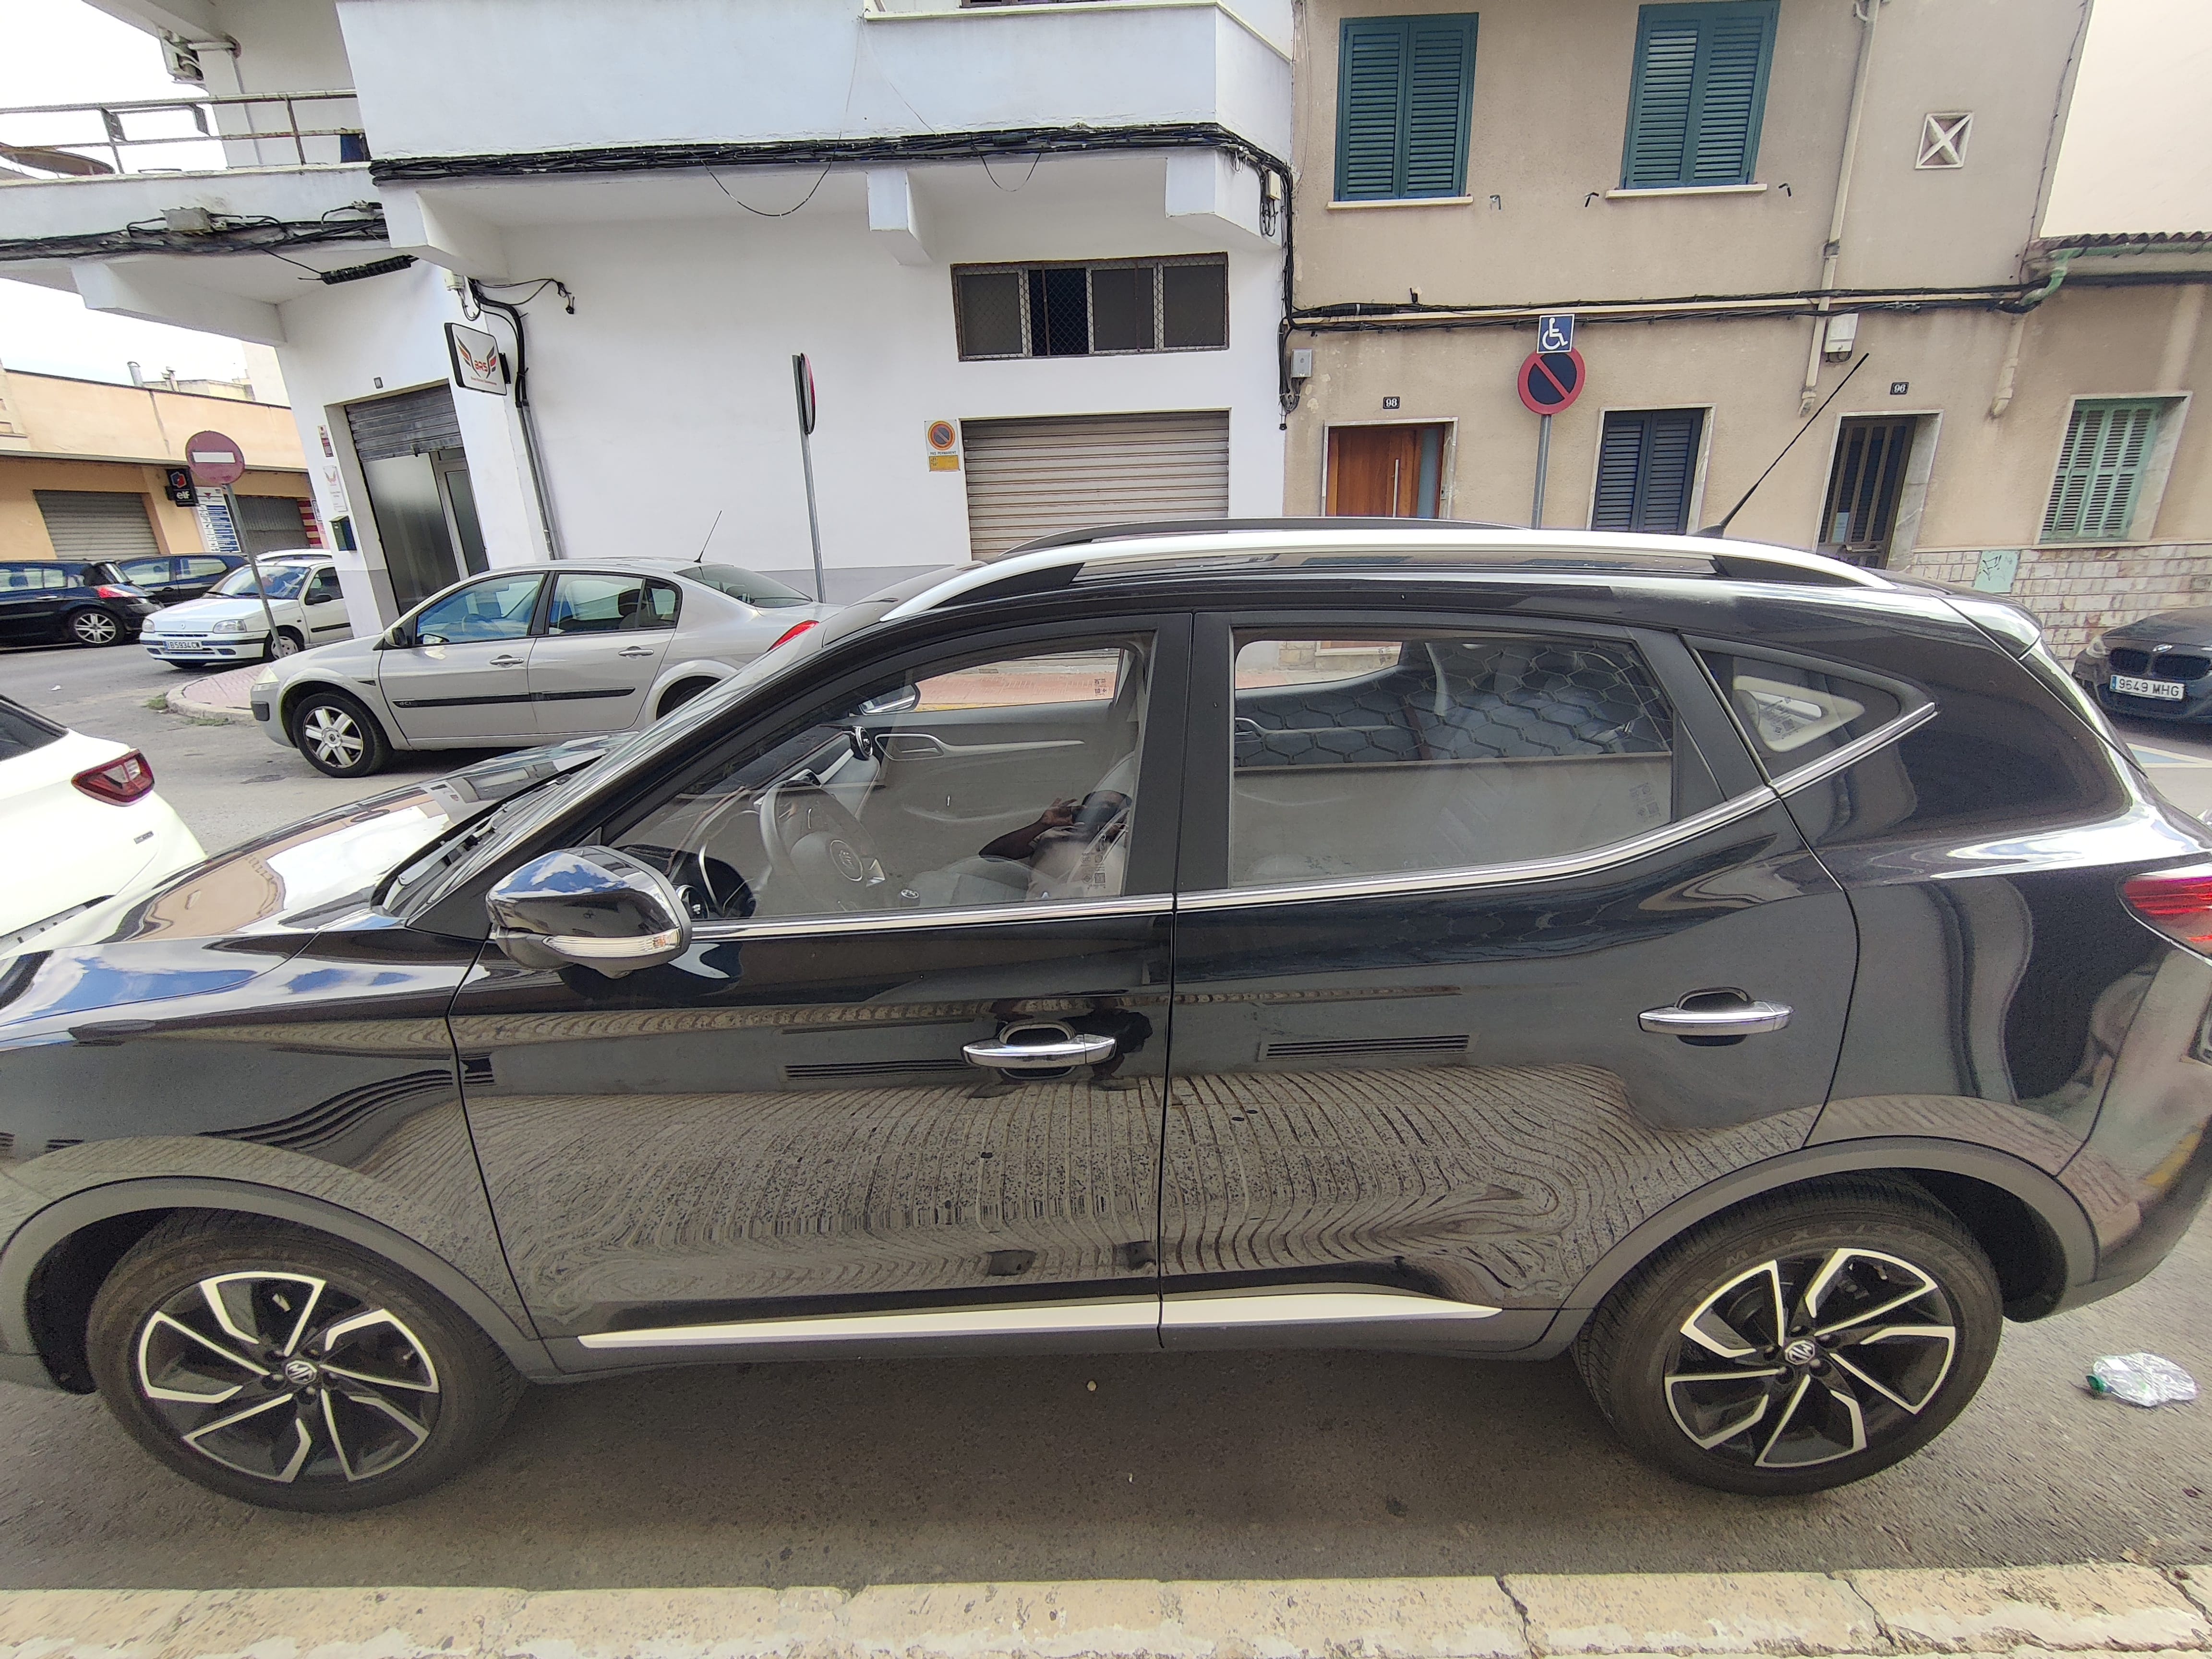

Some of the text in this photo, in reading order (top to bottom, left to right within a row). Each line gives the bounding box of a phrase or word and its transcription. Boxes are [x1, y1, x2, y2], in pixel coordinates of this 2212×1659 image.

[1894, 384, 1906, 393] 96
[1386, 398, 1397, 407] 98
[176, 491, 191, 500] elf
[2119, 678, 2179, 697] 9649 MHG
